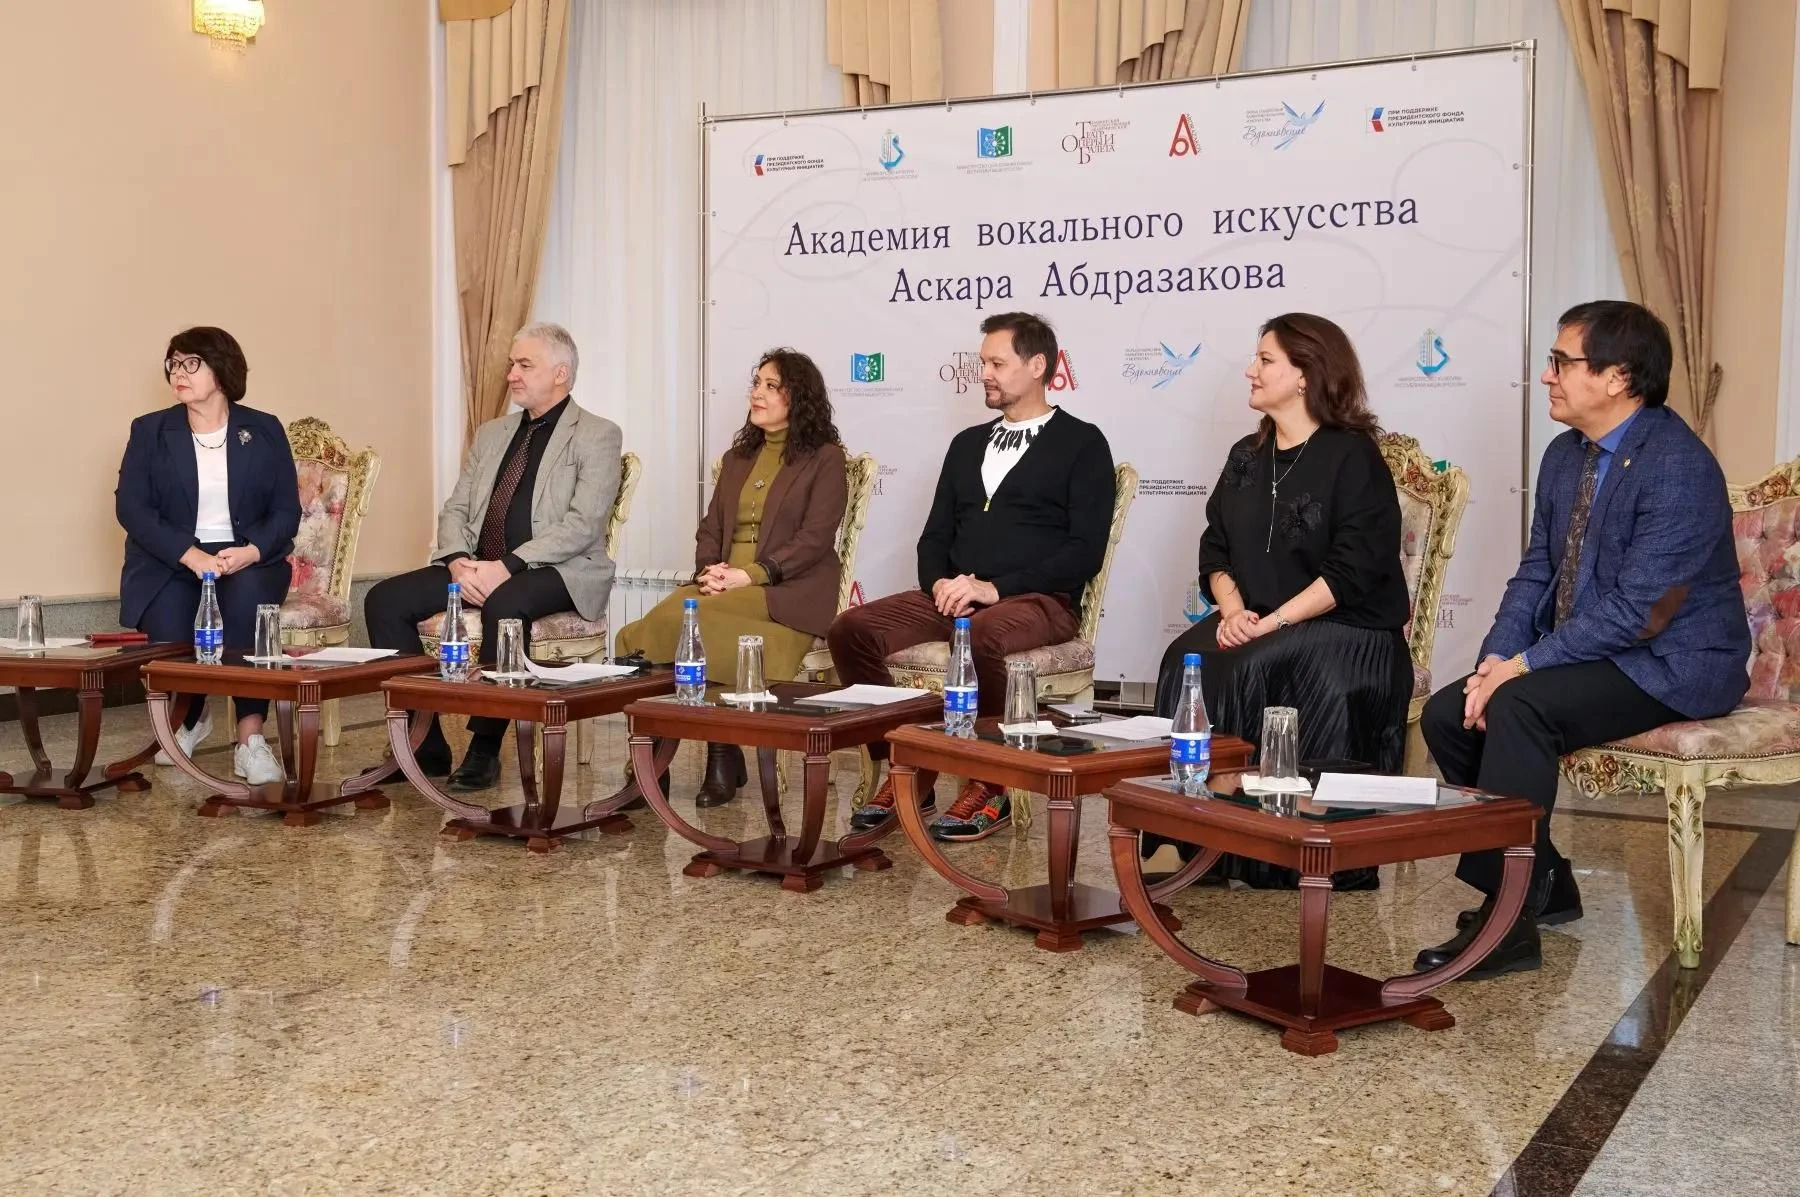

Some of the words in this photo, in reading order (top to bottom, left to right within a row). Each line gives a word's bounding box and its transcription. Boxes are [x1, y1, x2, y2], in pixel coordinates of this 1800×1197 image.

[1388, 113, 1441, 121] ПРЕЗИДЕНТСКОГО
[784, 222, 951, 257] Академия
[977, 212, 1183, 246] вокального
[1213, 199, 1418, 241] искусства
[889, 268, 1013, 309] Аскара
[1040, 261, 1285, 305] Абдразакова
